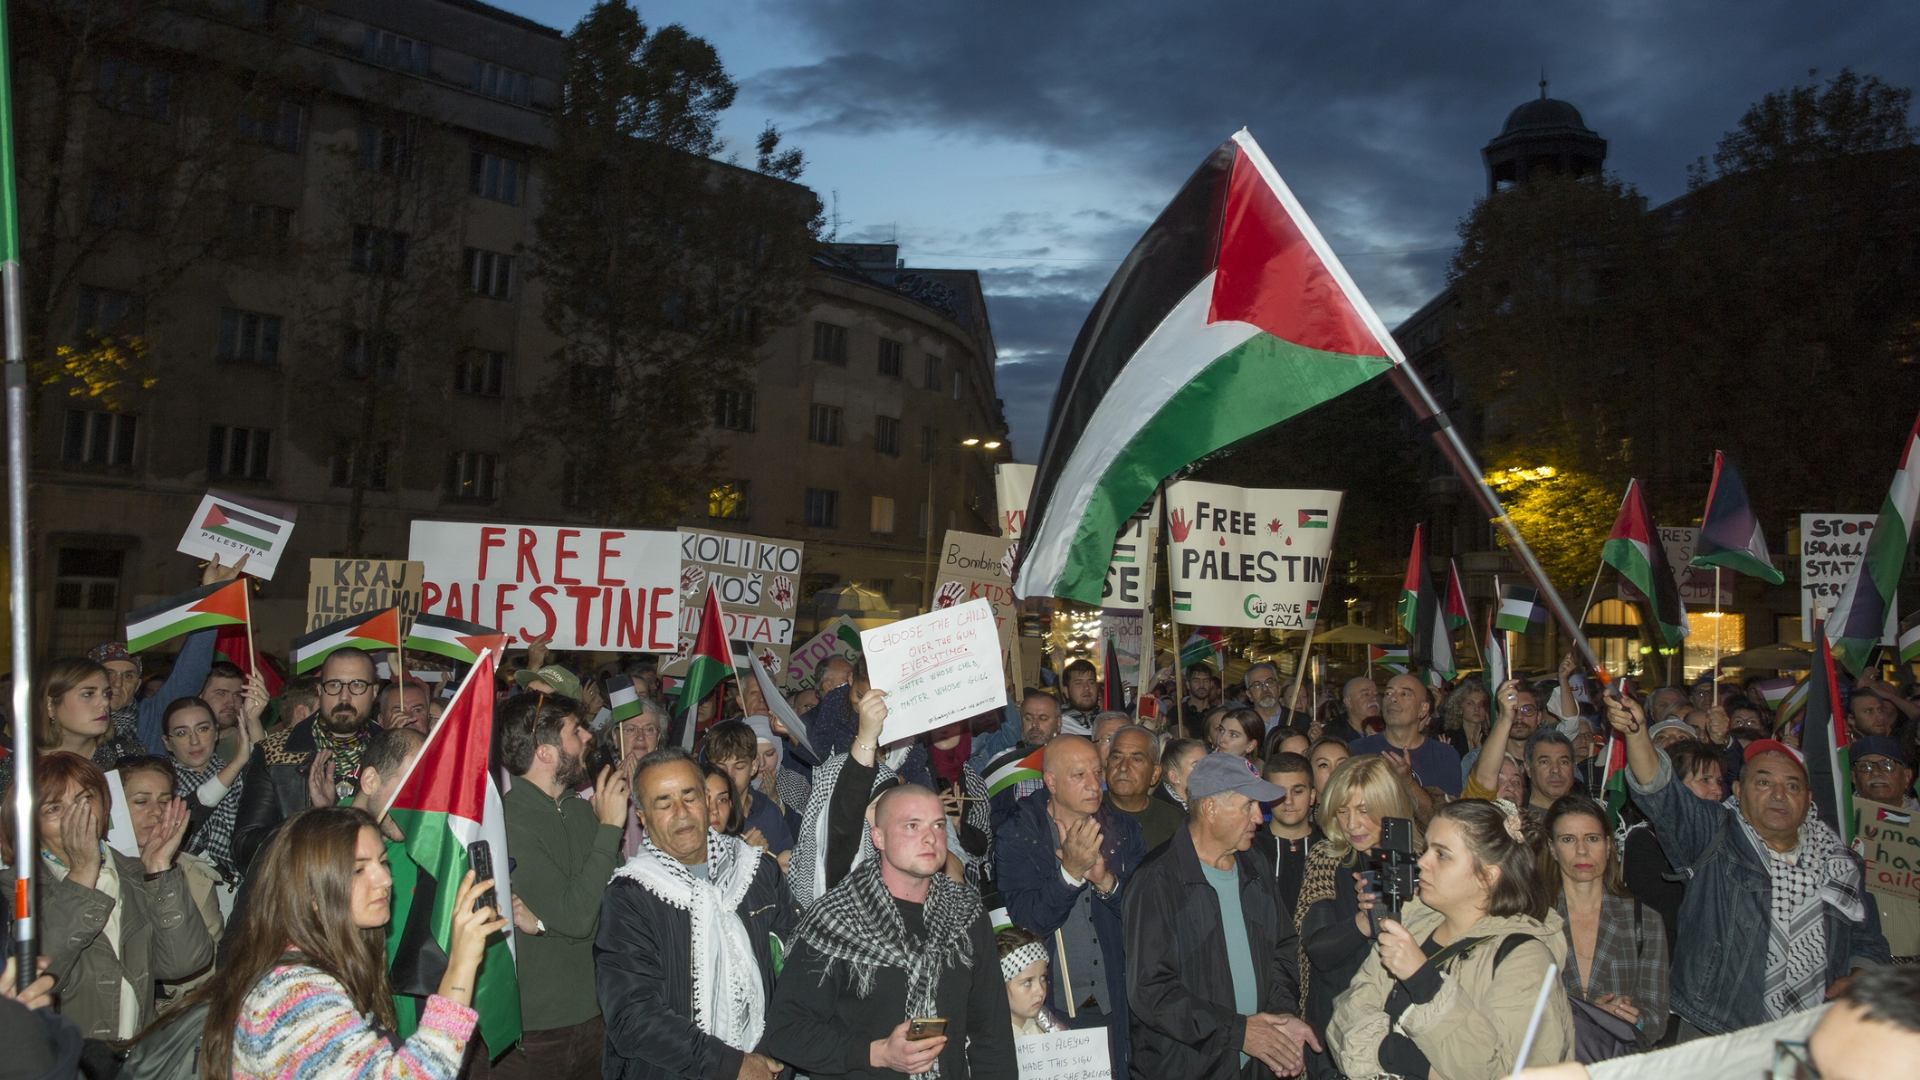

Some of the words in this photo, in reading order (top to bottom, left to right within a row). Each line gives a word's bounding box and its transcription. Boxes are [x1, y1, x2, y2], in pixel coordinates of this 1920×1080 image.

[1196, 501, 1256, 536] FREE
[1810, 519, 1874, 537] STOP
[201, 532, 264, 557] PALESTINA
[478, 527, 626, 586] FREE
[681, 535, 799, 572] KOLIKO
[1804, 540, 1863, 556] ISRAEL
[946, 543, 1002, 576] Bombing
[334, 560, 407, 589] KRAJ
[970, 582, 1013, 606] KIDS
[422, 582, 675, 649] PALESTINE
[1264, 615, 1303, 628] GAZA
[1272, 603, 1300, 614] SAVE
[867, 625, 925, 653] CHOOSE
[928, 618, 950, 632] THE
[957, 607, 988, 626] CHILD
[789, 632, 837, 680] STOP
[908, 642, 934, 657] OVER
[935, 636, 951, 647] THE
[900, 677, 924, 693] MATTER
[930, 666, 953, 681] WHOSE
[900, 692, 929, 710] MATTER
[934, 681, 961, 696] WHOSE
[1042, 1042, 1050, 1052] IS
[1055, 1037, 1090, 1049] ALEYNA
[1022, 1060, 1044, 1072] MADE
[1048, 1058, 1068, 1069] THIS
[1073, 1056, 1092, 1065] SIGN
